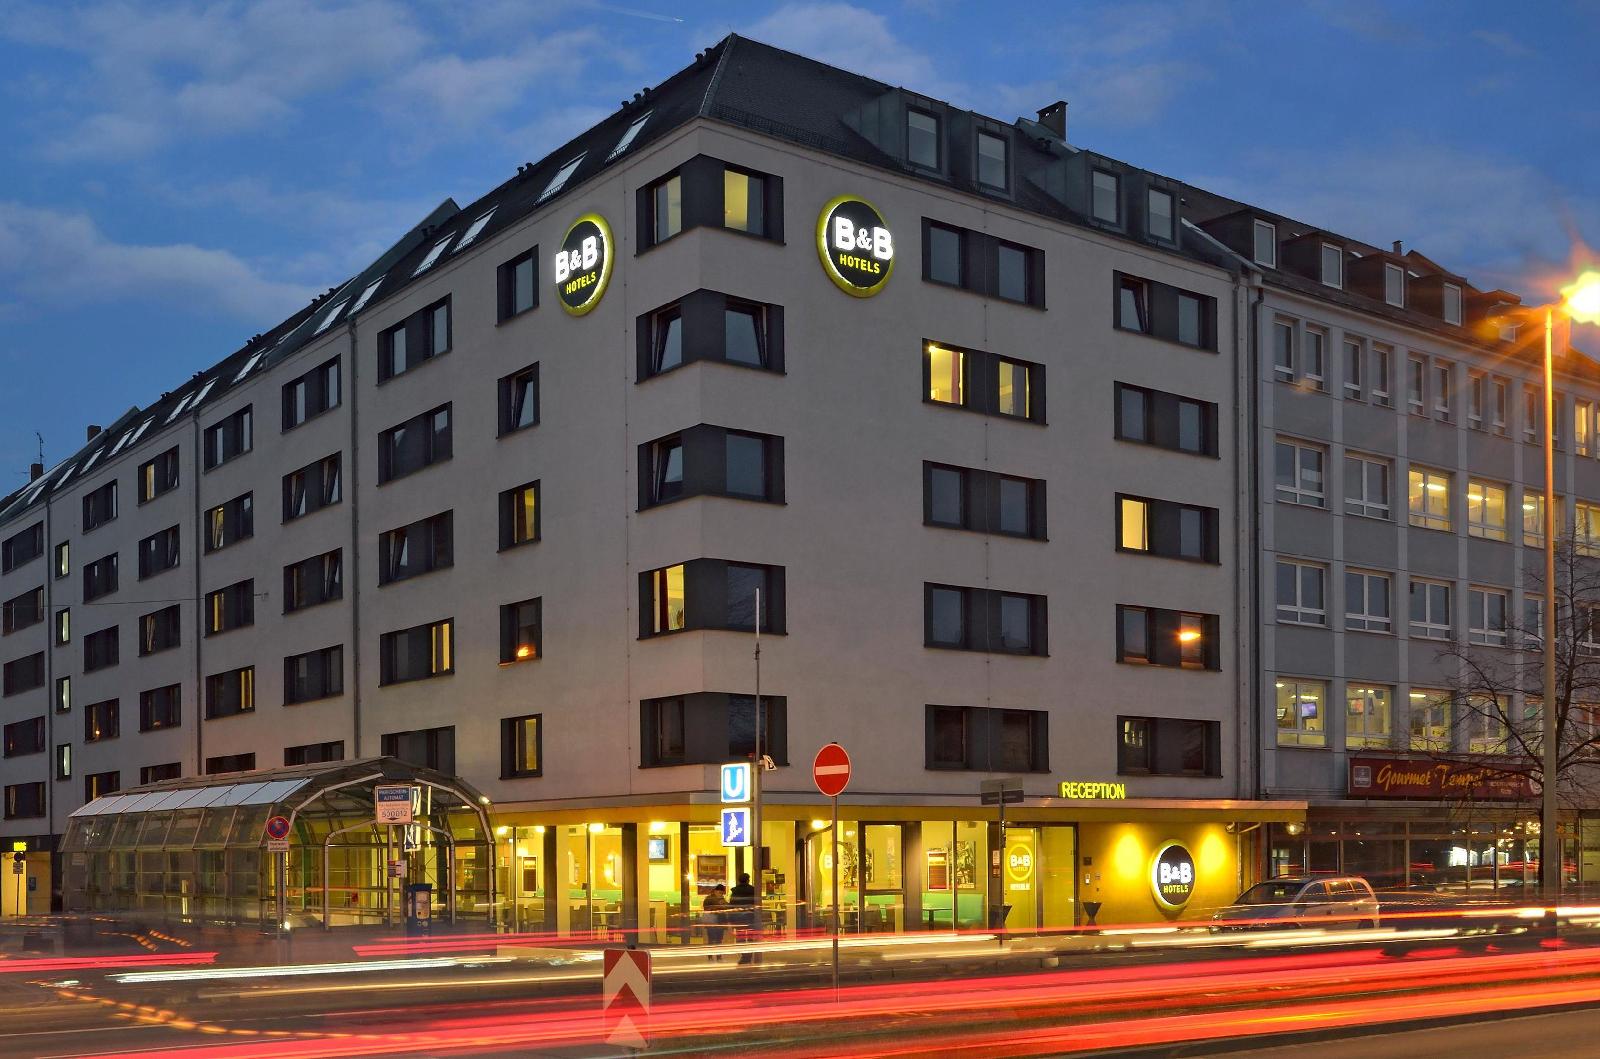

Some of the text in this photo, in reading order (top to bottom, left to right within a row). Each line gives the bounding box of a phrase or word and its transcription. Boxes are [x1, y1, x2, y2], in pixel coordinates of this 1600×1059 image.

[833, 216, 894, 261] B&B
[555, 235, 598, 284] B&B
[839, 253, 881, 274] HOTELS
[566, 271, 597, 295] HOTELS
[724, 768, 743, 798] U
[1376, 763, 1431, 792] Gourmet
[1060, 781, 1125, 799] RECEPTION
[1160, 862, 1193, 884] B&B
[1163, 884, 1189, 893] HOTELS
